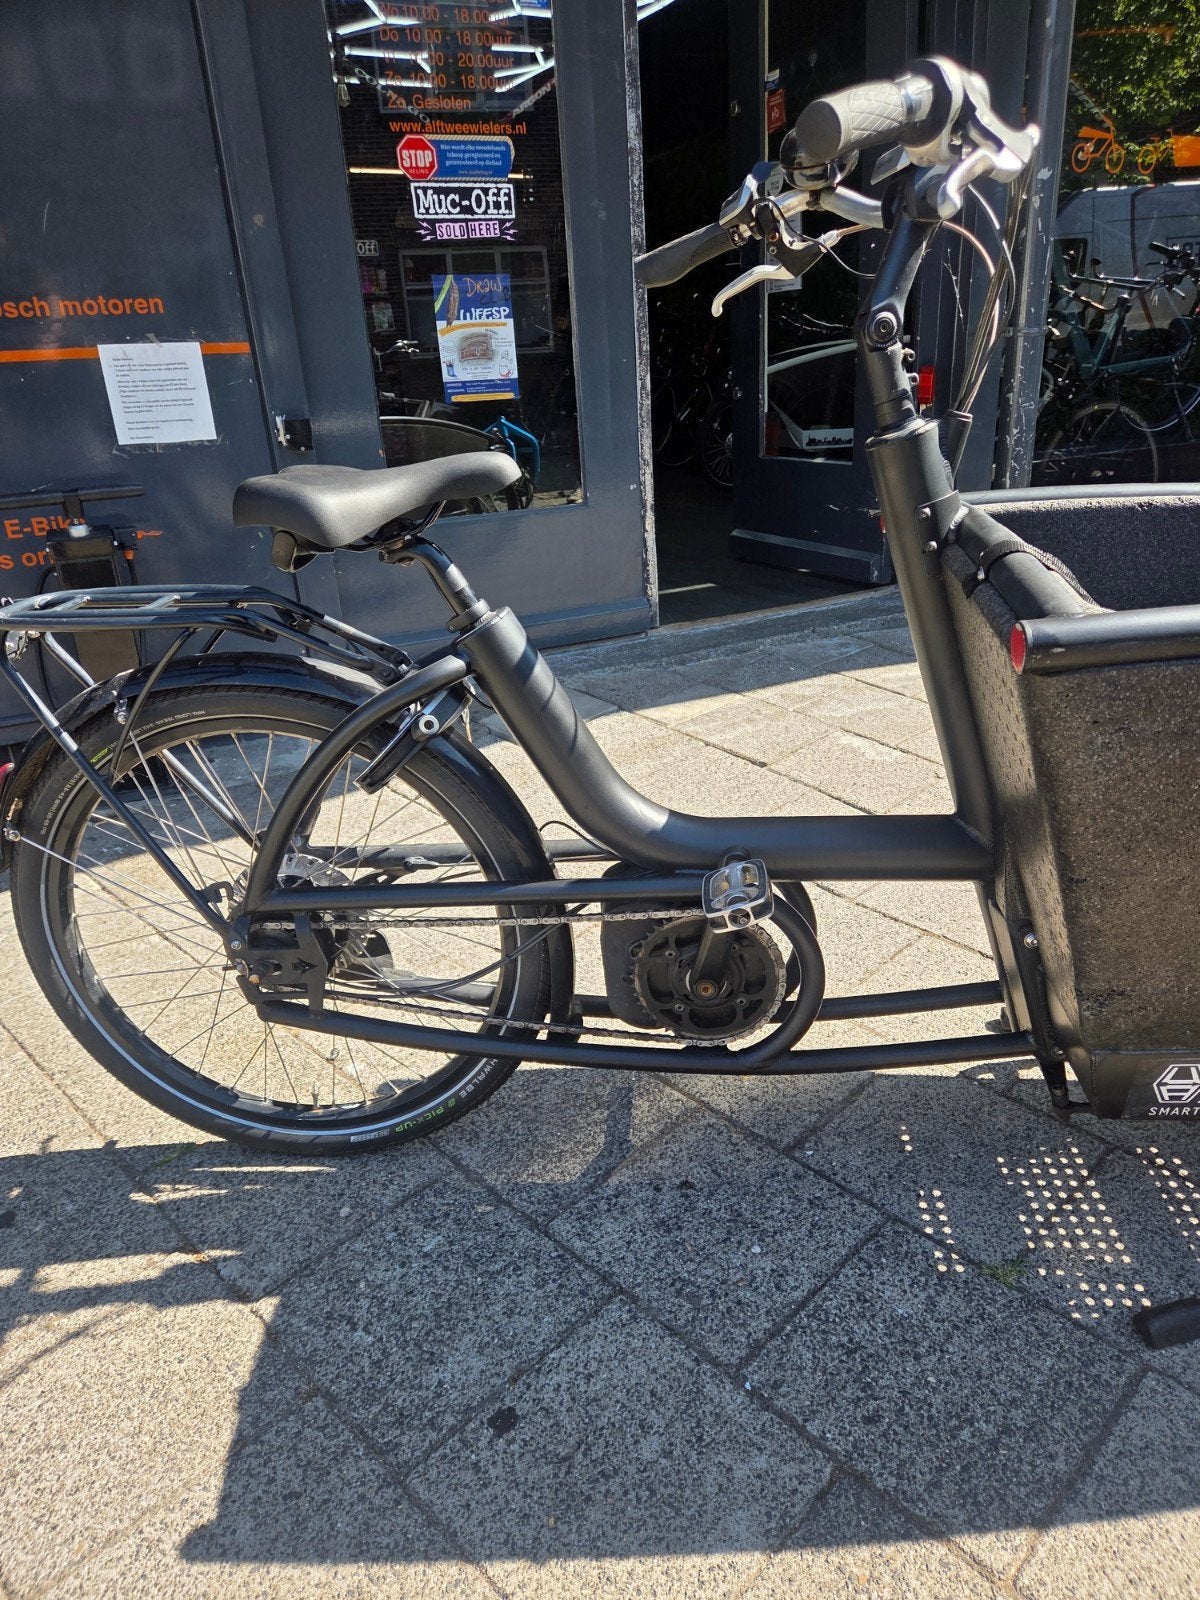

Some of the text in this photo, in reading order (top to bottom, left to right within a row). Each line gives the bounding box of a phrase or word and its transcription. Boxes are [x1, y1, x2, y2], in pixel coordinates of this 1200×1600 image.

[381, 27, 399, 41] Do
[413, 93, 472, 110] Gesloten
[389, 120, 527, 135] www.alftweewielers.nl
[401, 150, 433, 168] STOP
[417, 188, 509, 214] Muc-Off
[438, 223, 499, 238] SOLD HERE
[0, 295, 165, 318] sch motoren
[395, 1106, 445, 1132] PICK-UP
[1148, 1106, 1200, 1116] SMART
